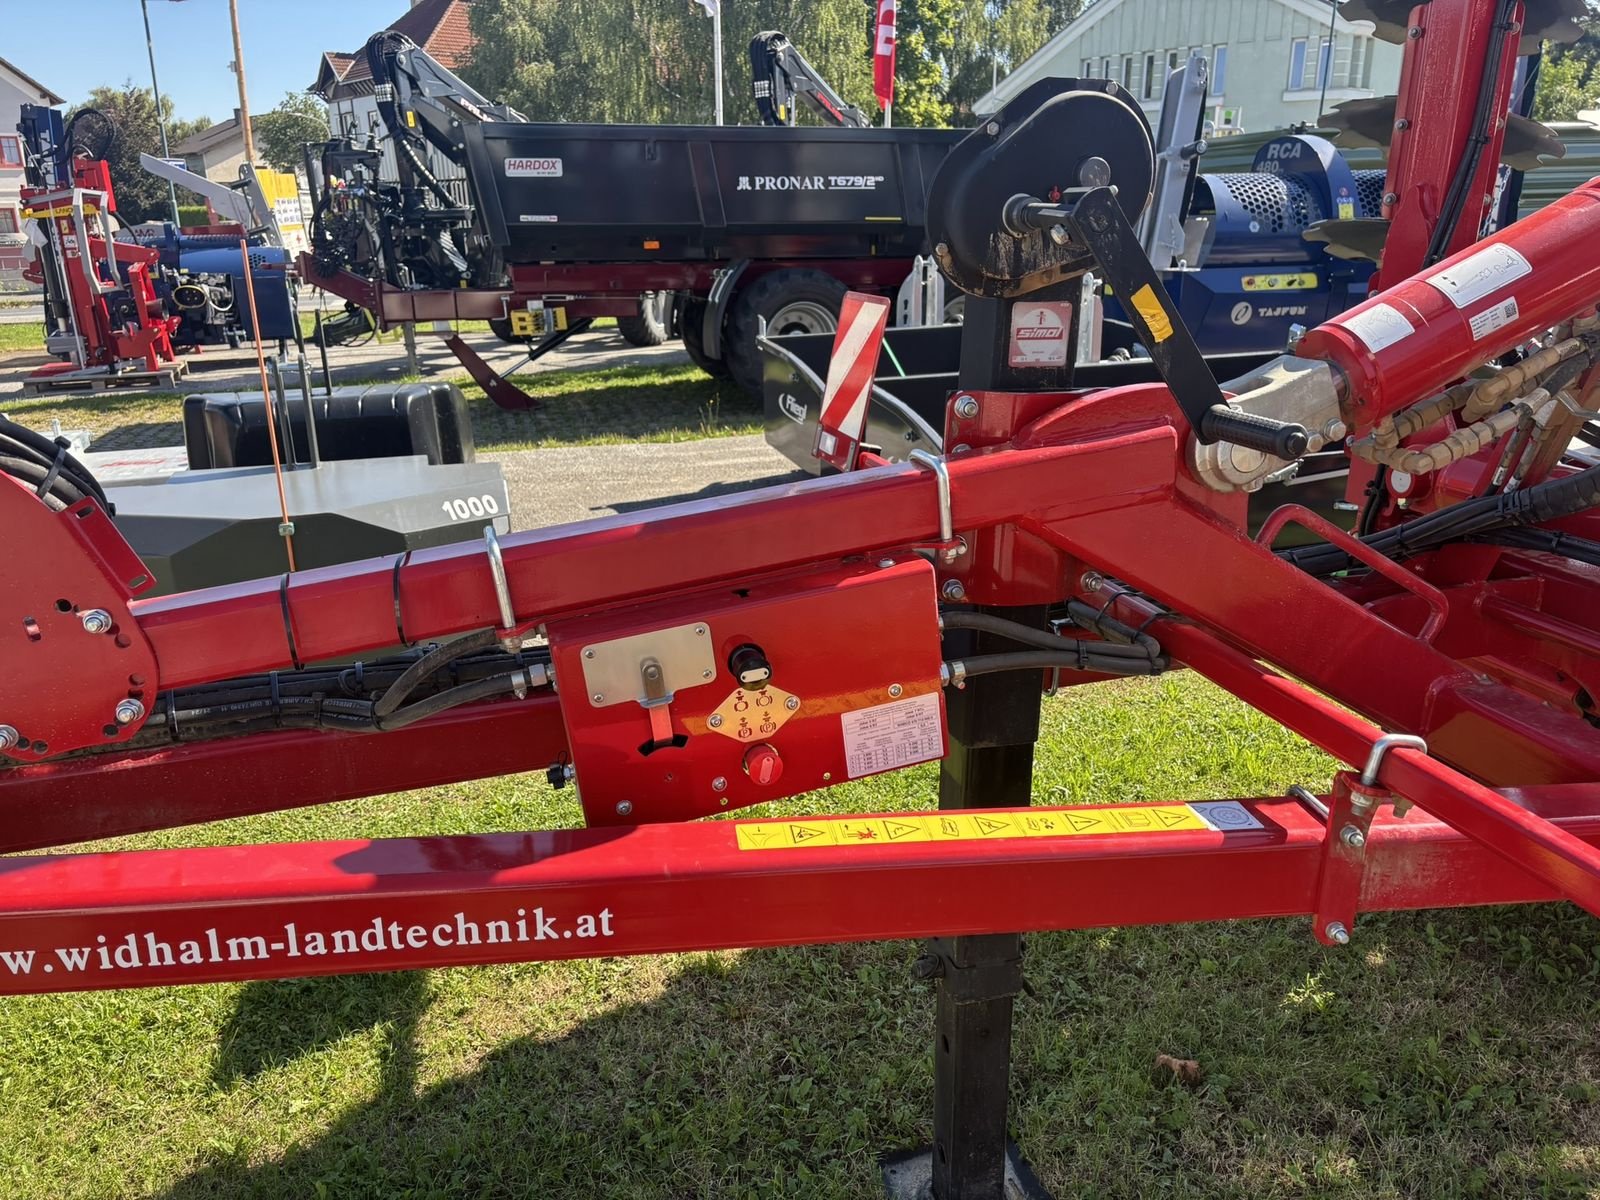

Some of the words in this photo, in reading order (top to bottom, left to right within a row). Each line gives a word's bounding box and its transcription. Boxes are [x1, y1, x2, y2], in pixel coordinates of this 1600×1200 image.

[1267, 142, 1301, 159] RCA
[508, 160, 558, 171] HARDOX
[754, 175, 826, 190] PRONAR
[1258, 305, 1307, 317] TAJFUN
[441, 494, 499, 521] 1000
